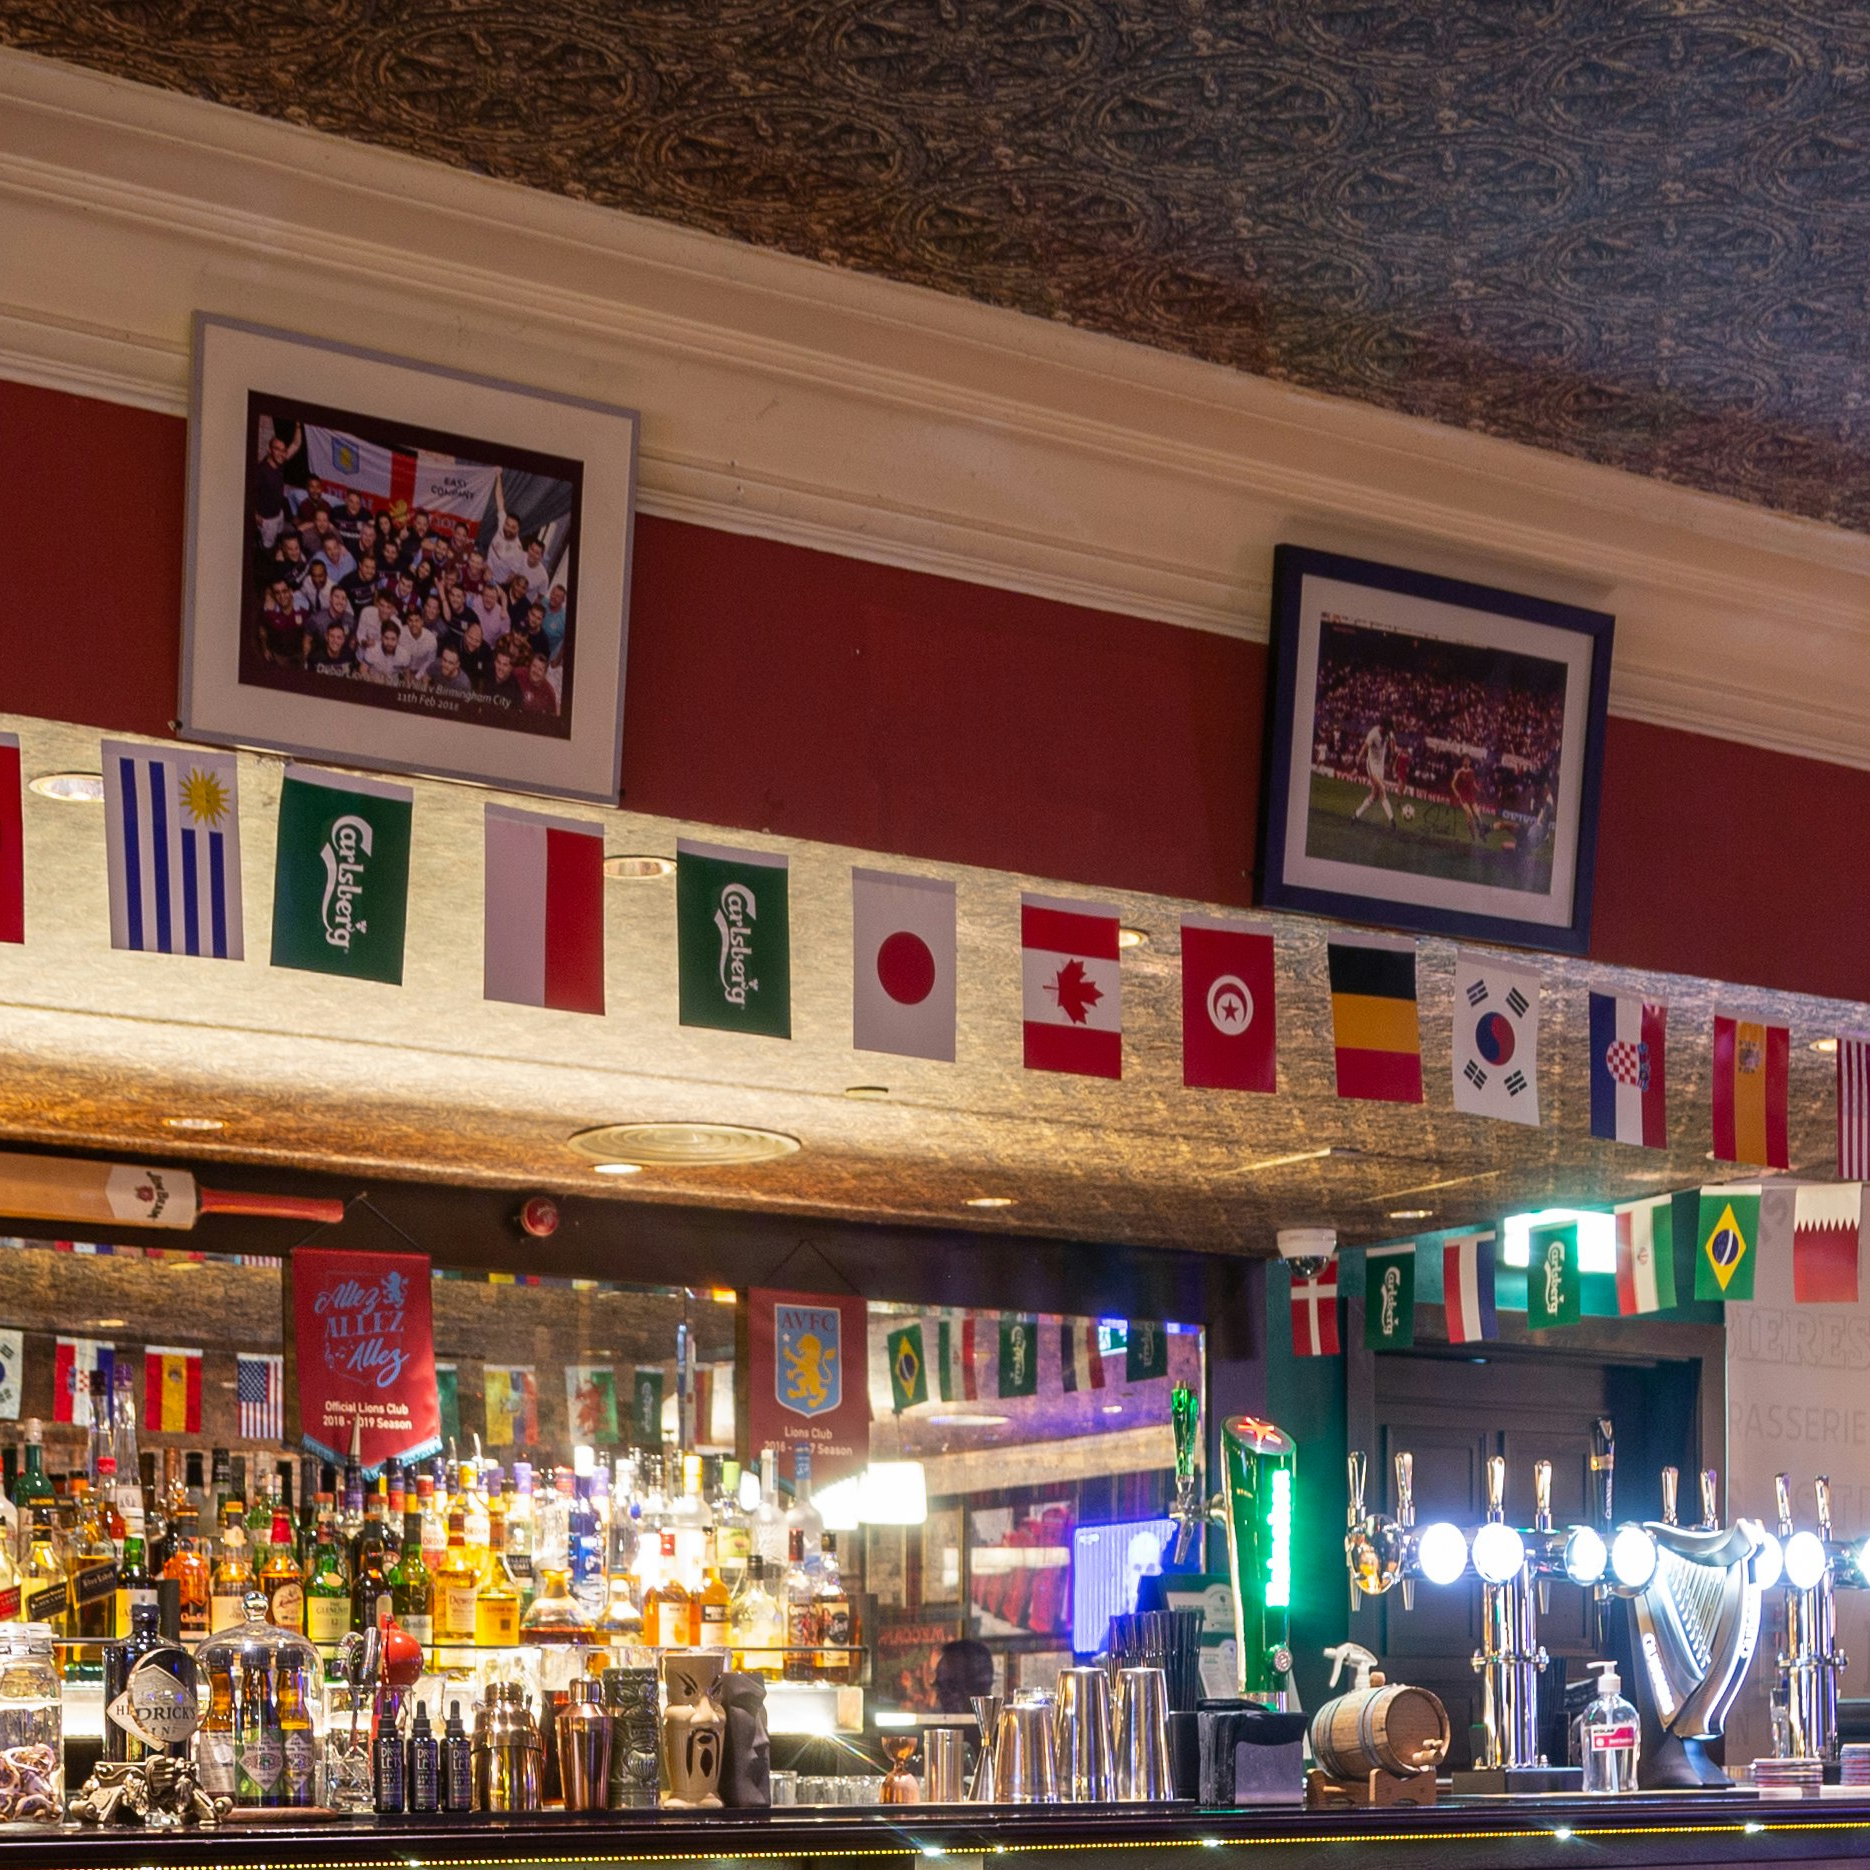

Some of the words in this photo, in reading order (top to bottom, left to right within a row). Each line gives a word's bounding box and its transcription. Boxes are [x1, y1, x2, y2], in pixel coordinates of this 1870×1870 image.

[419, 695, 435, 706] Feb
[435, 683, 491, 703] Birmingham
[493, 694, 511, 710] City
[319, 814, 373, 955] Carlsberg
[714, 882, 758, 1010] Carlsberg
[1544, 1240, 1566, 1316] Carlsberg
[1381, 1266, 1400, 1336] Carlsberg
[324, 1311, 404, 1338] ALLEZ
[782, 1311, 835, 1332] AVFC
[347, 1338, 410, 1388] Allez
[325, 1401, 357, 1414] Official
[358, 1402, 385, 1414] Lions
[386, 1403, 409, 1415] Club
[323, 1415, 345, 1427] 2018
[377, 1418, 412, 1430] Season
[784, 1426, 810, 1438] Lions
[811, 1427, 833, 1440] Club
[817, 1443, 853, 1456] Season
